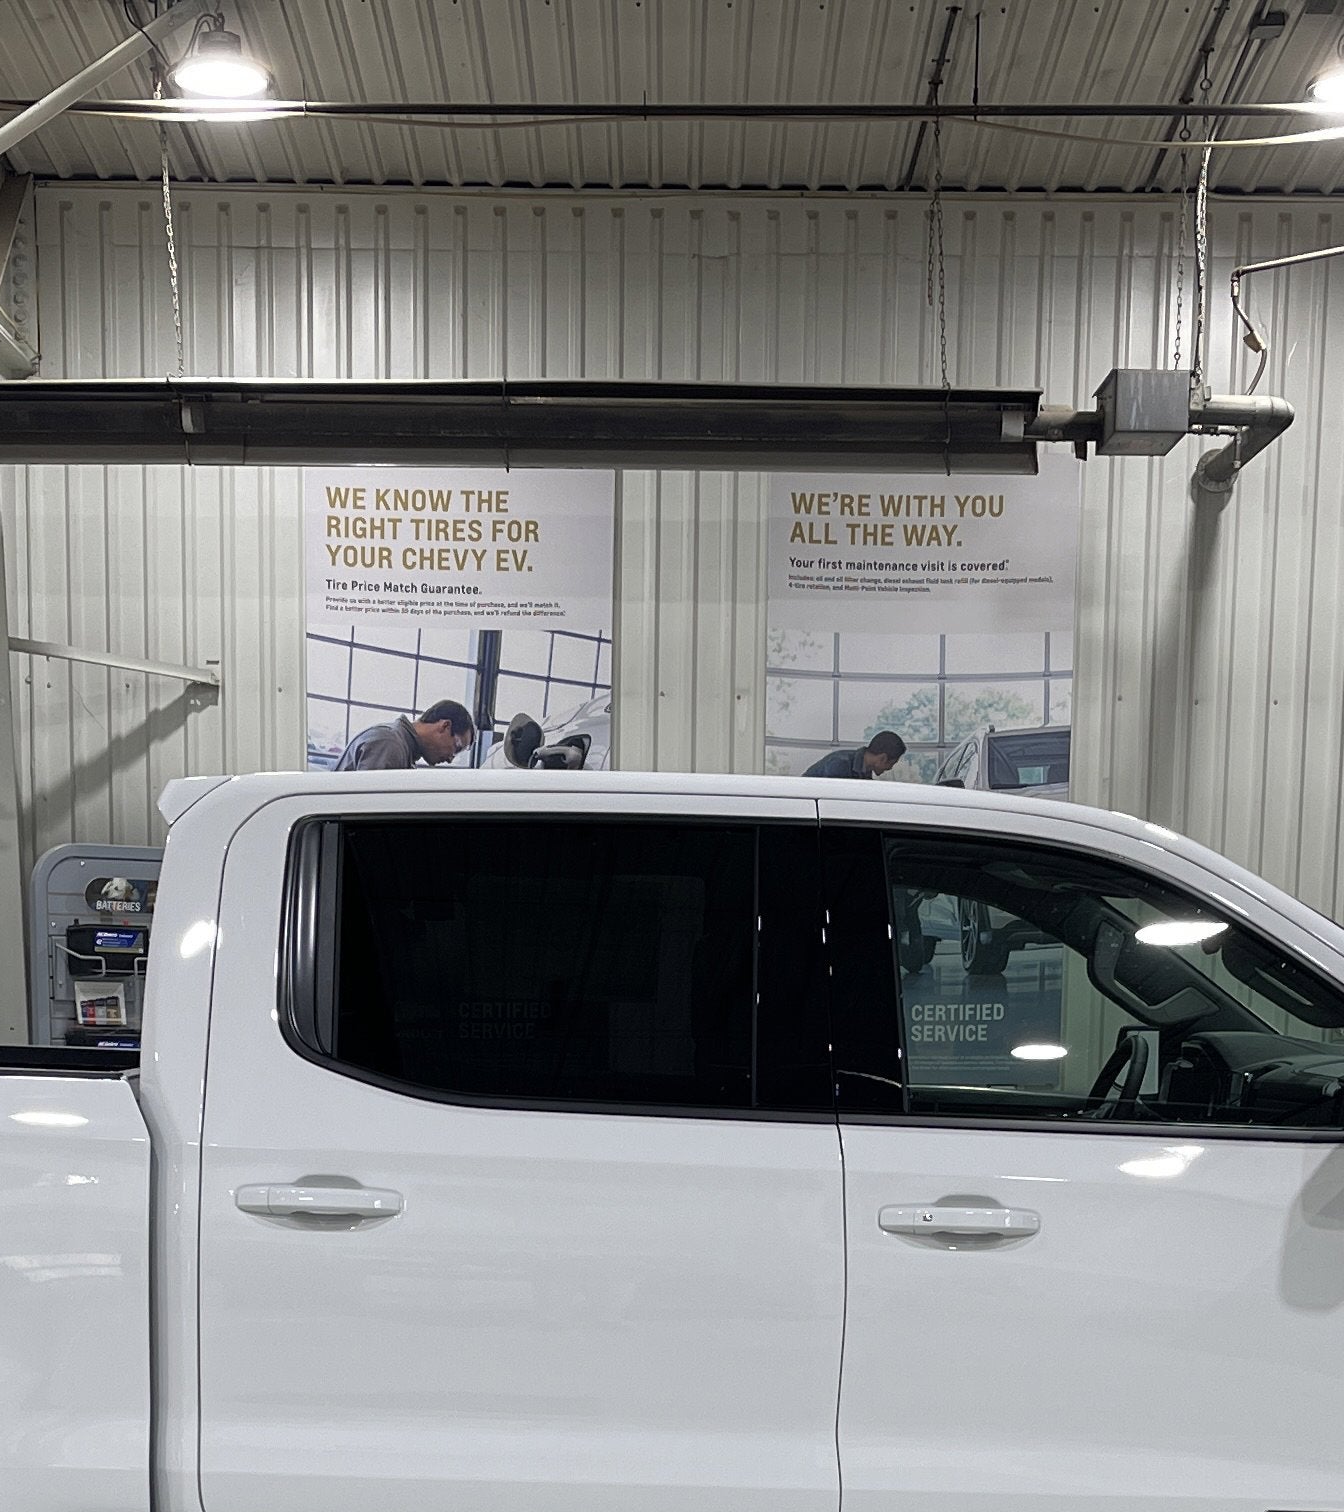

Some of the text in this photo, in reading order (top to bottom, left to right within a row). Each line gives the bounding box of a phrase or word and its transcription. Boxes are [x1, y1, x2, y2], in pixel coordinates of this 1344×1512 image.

[326, 486, 509, 513] WE KNOW THE
[791, 492, 1004, 518] WE'RE WITH YOU
[326, 515, 539, 543] RIGHT TIRES FOR
[790, 521, 962, 547] ALL THE WAY.
[326, 544, 534, 572] YOUR CHEVY EV.
[789, 556, 814, 568] Your
[818, 558, 842, 570] first
[846, 560, 918, 571] maintenance
[921, 560, 944, 571] visit
[948, 560, 957, 571] is
[326, 579, 482, 594] Tire Price Match Guarantee.
[96, 900, 140, 912] BATTERIES
[911, 1003, 1004, 1021] CERTIFIED
[911, 1024, 988, 1041] SERVICE
